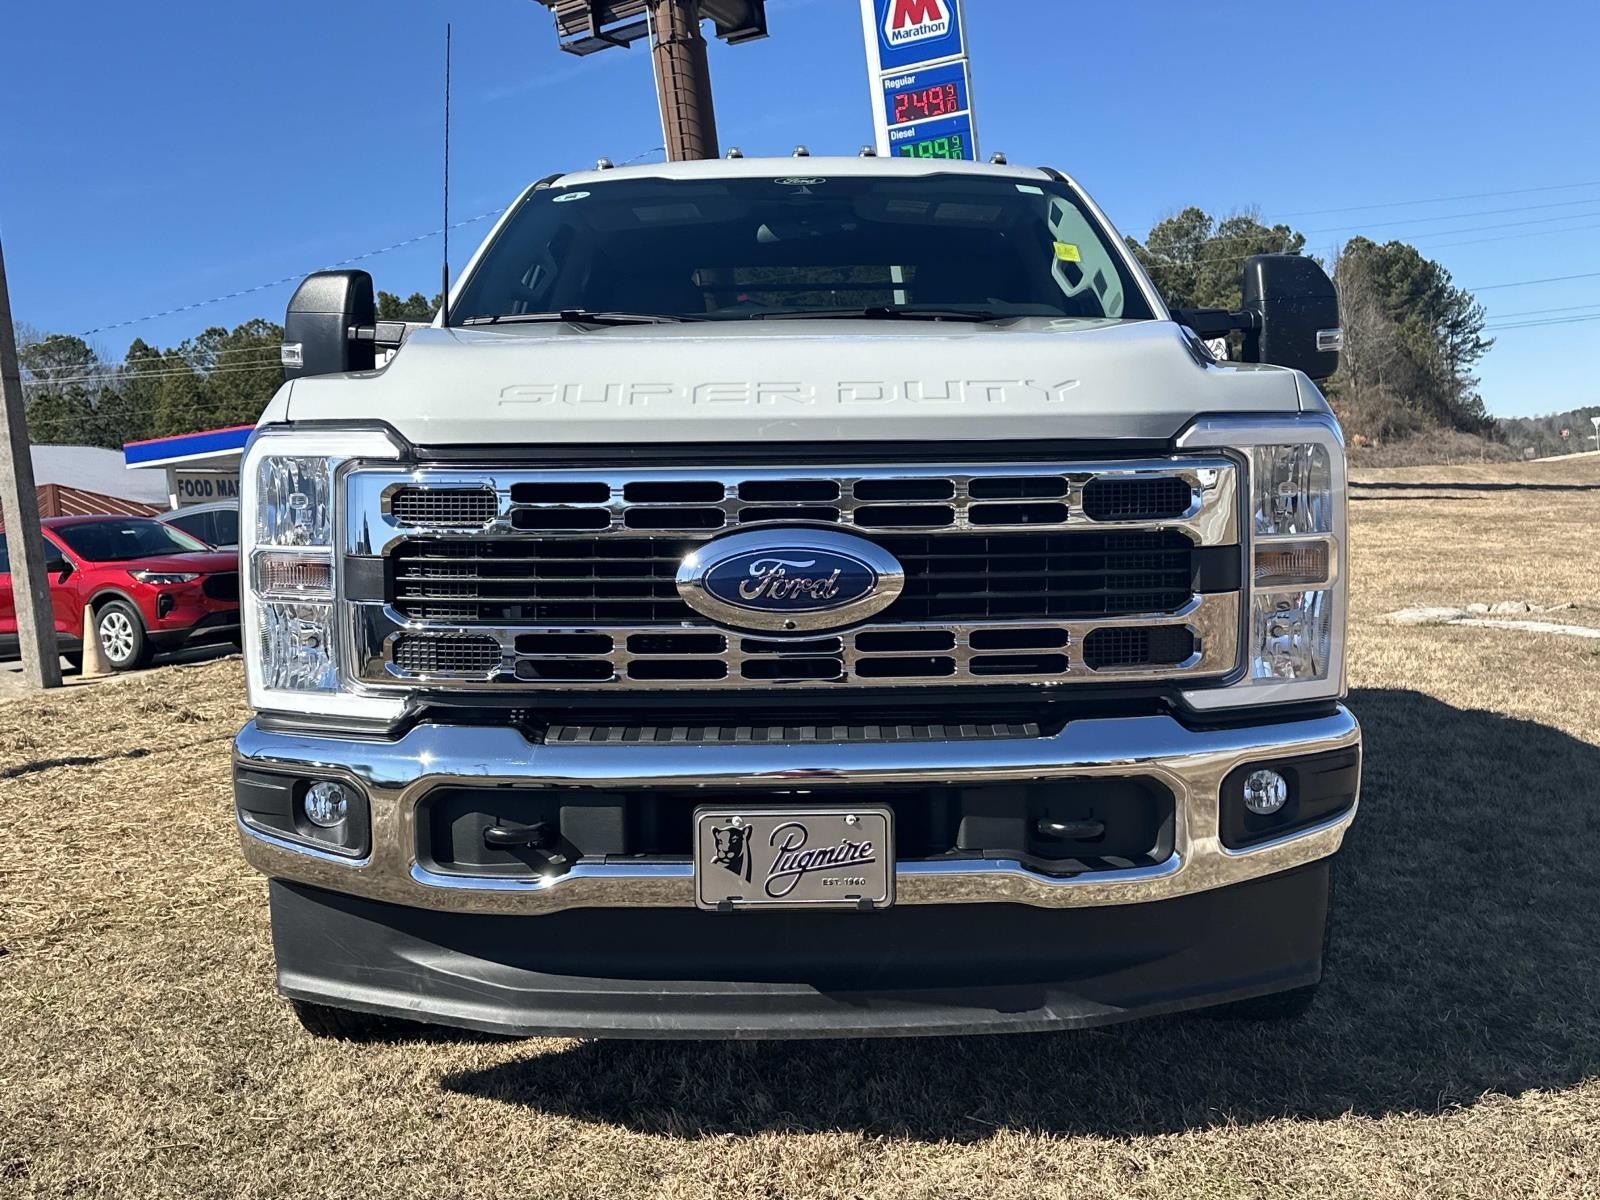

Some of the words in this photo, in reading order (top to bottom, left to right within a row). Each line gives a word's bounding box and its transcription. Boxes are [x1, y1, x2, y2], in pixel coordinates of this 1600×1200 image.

[891, 21, 946, 42] Marathon
[884, 75, 916, 90] Regular
[890, 127, 915, 141] Diesel
[498, 382, 816, 406] SUPER
[837, 379, 1081, 404] DUTY
[177, 479, 213, 497] FOOD
[738, 558, 842, 600] Ford
[764, 821, 876, 898] Pugmire
[822, 877, 841, 886] EST.
[843, 877, 866, 886] 1960
